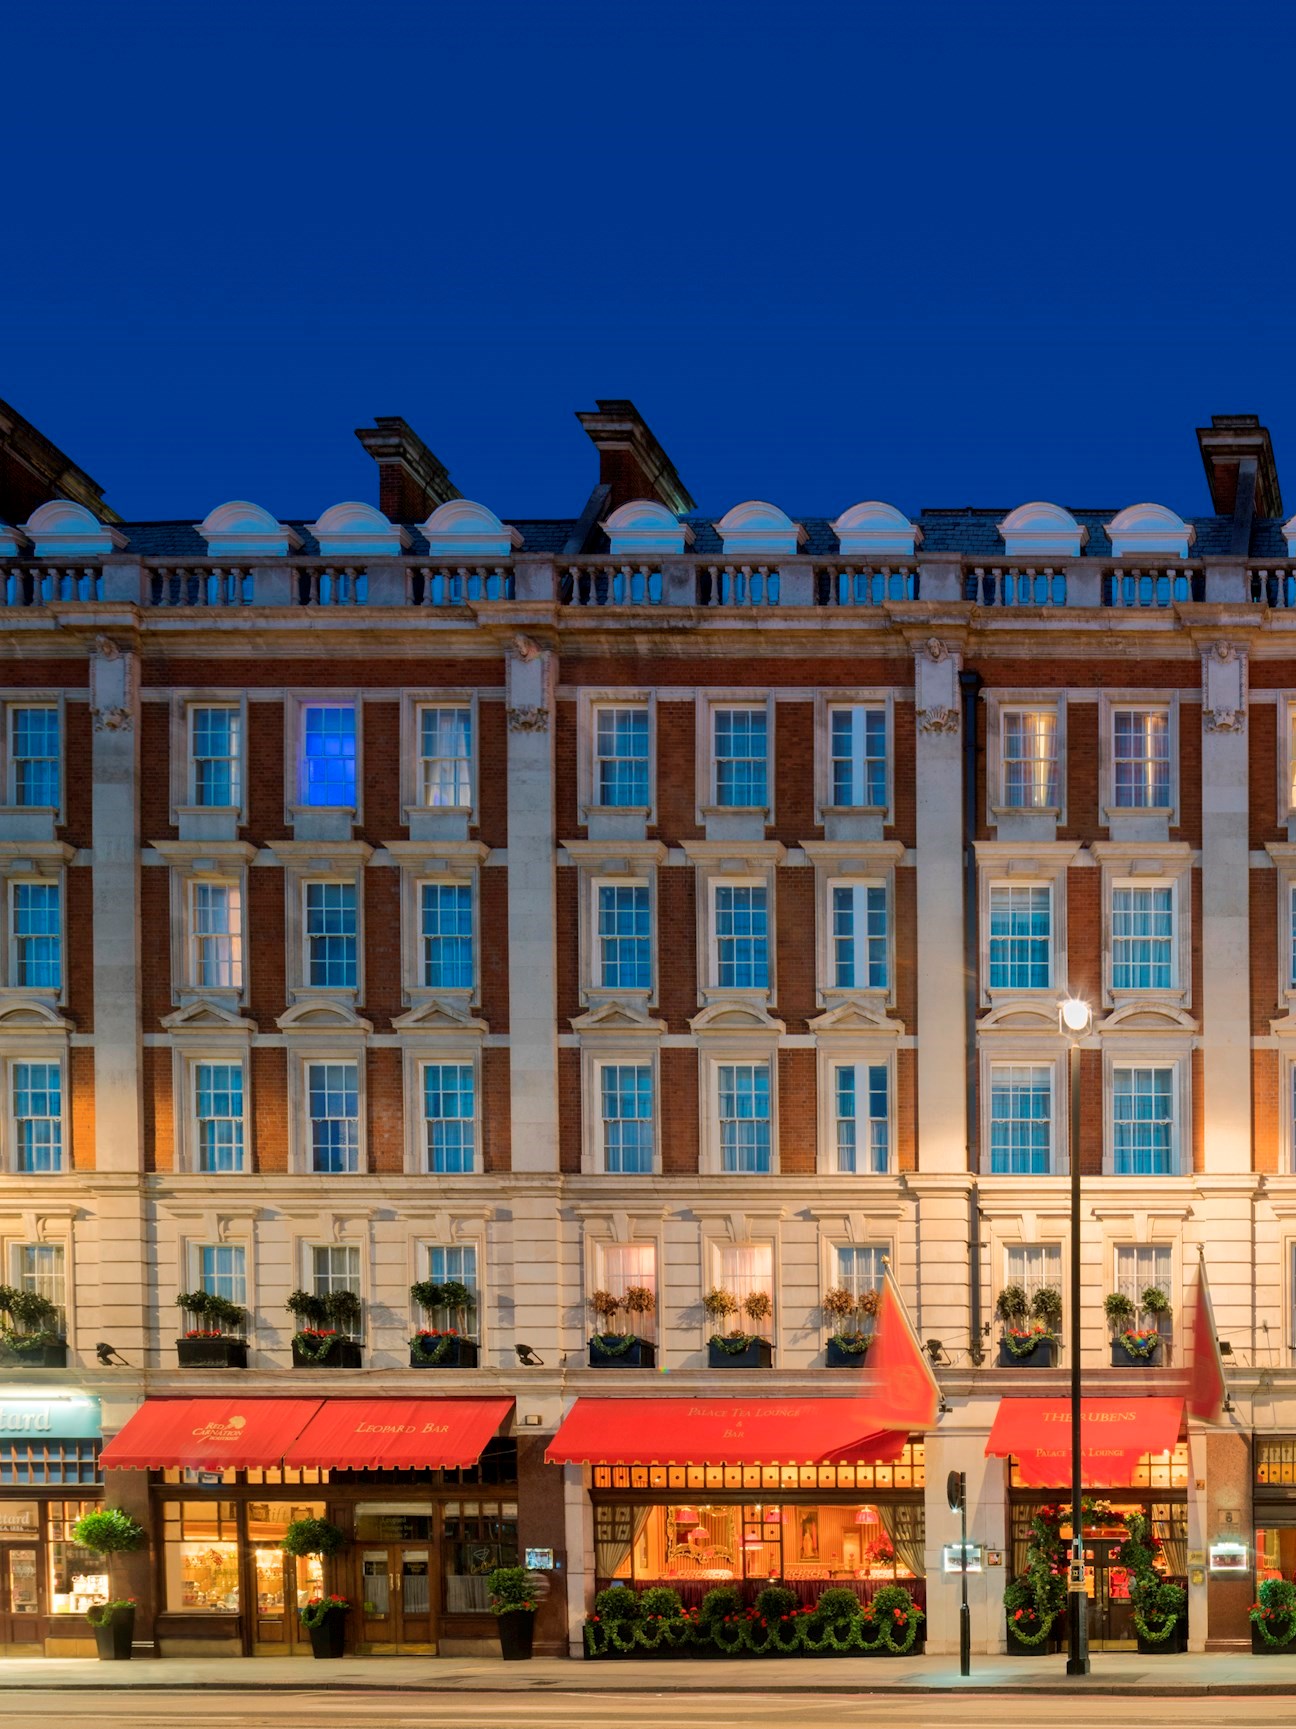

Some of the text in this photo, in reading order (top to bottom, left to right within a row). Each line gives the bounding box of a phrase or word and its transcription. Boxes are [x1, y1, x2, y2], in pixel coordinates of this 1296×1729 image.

[732, 1408, 750, 1417] TEA
[1042, 1411, 1137, 1422] THE RUBENS
[205, 1422, 225, 1430] RED
[354, 1421, 450, 1434] LEOPARD BAR
[191, 1427, 243, 1436] CARNATION
[723, 1429, 744, 1438] BAR
[1036, 1448, 1066, 1457] PALACE
[1088, 1448, 1124, 1457] LOUNGE
